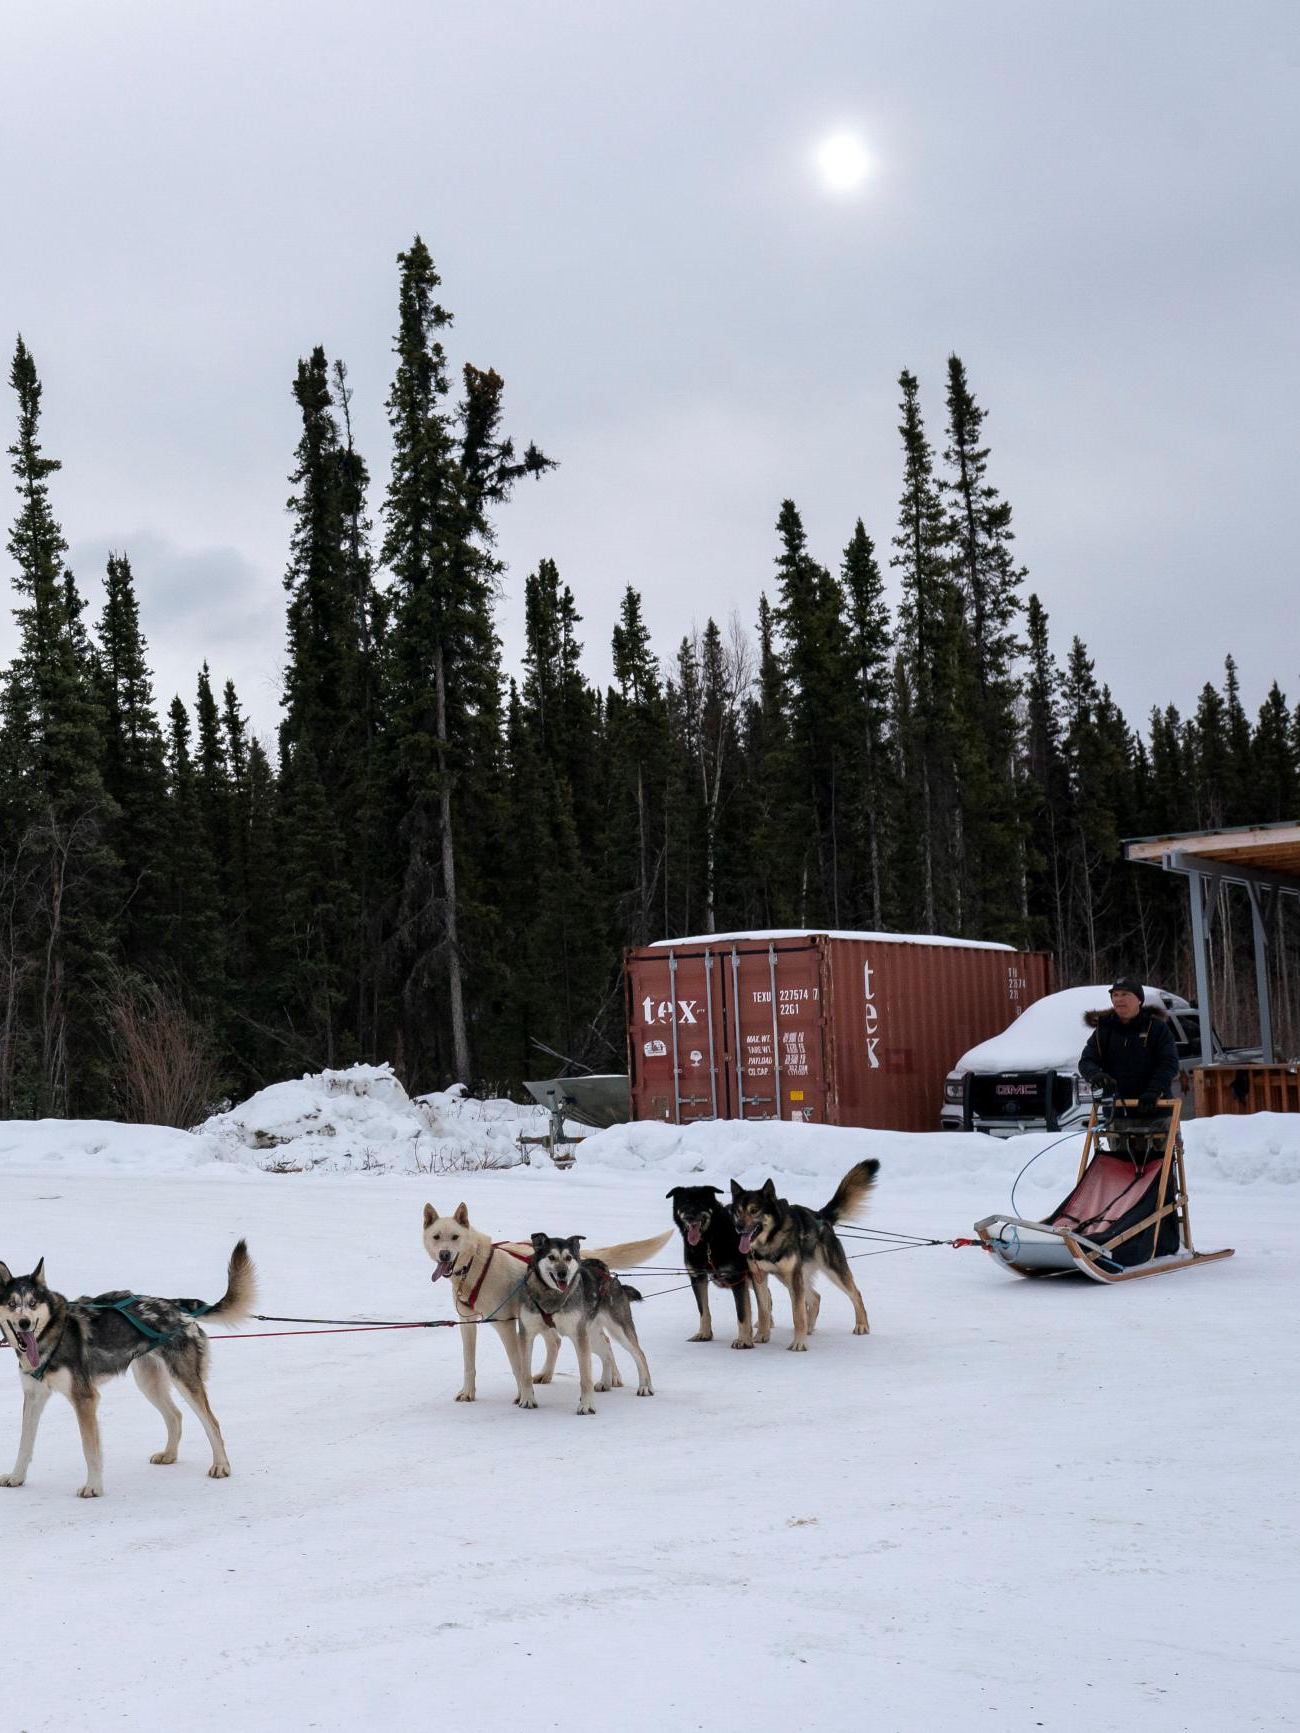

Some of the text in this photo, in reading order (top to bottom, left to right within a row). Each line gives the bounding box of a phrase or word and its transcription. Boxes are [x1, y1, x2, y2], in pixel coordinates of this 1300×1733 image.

[753, 988, 819, 1002] TEXU 227574 7
[642, 996, 697, 1024] tex
[781, 1003, 798, 1014] 22G1
[748, 1056, 772, 1064] PAYLOAD
[996, 1084, 1037, 1094] GMC
